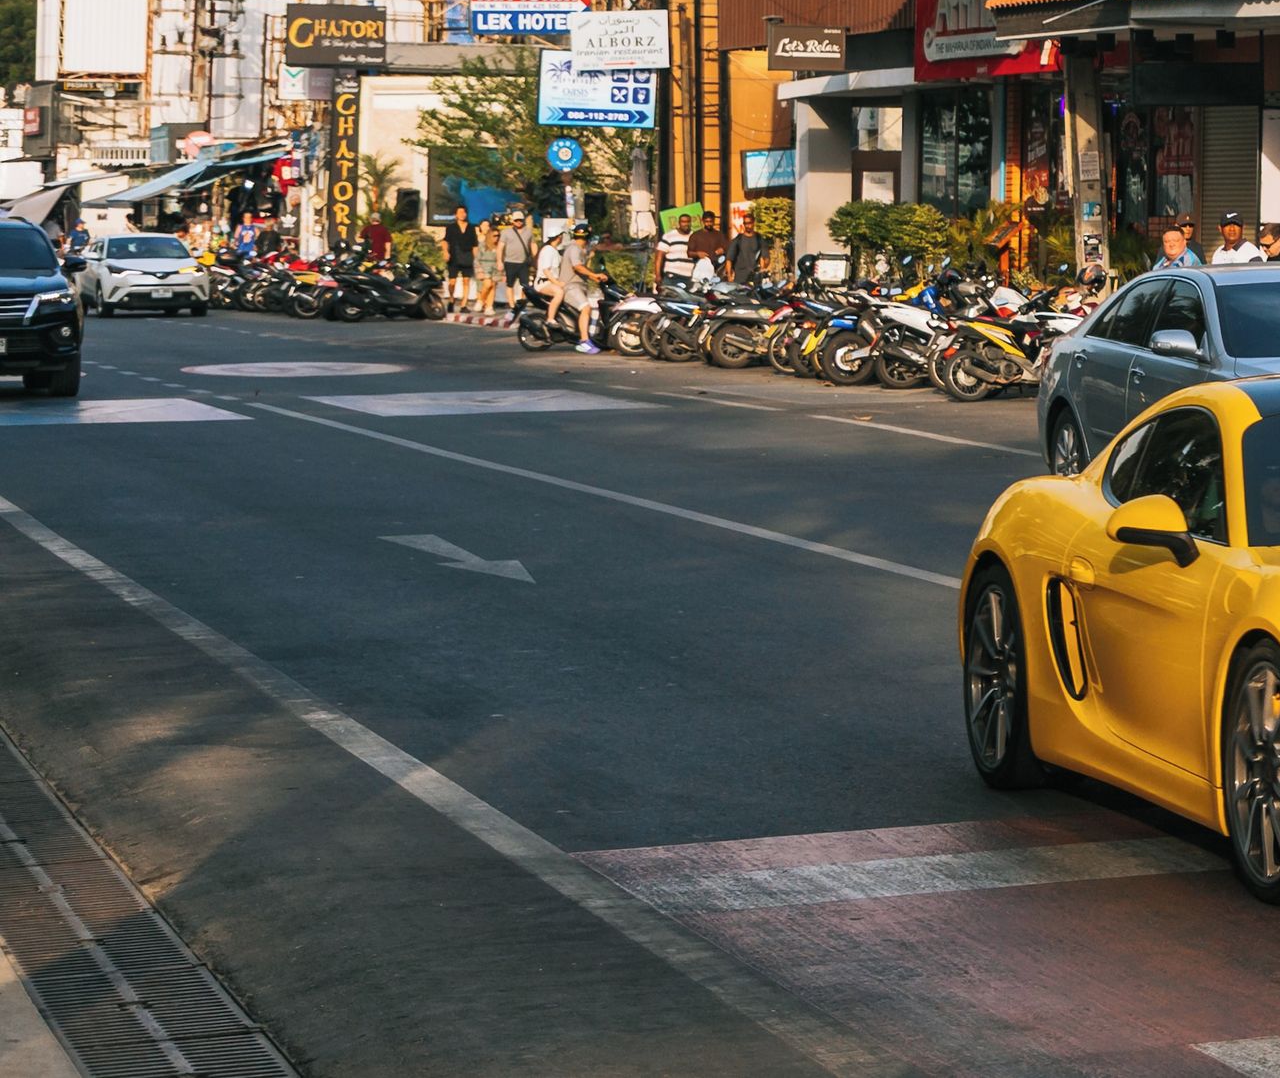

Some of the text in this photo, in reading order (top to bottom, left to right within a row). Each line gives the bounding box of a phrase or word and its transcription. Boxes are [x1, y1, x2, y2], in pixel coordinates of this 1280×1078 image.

[476, 13, 568, 31] LEK HOTE
[288, 17, 385, 48] CHATORI
[586, 36, 656, 48] ALBORZ
[775, 38, 841, 57] Let's Relax
